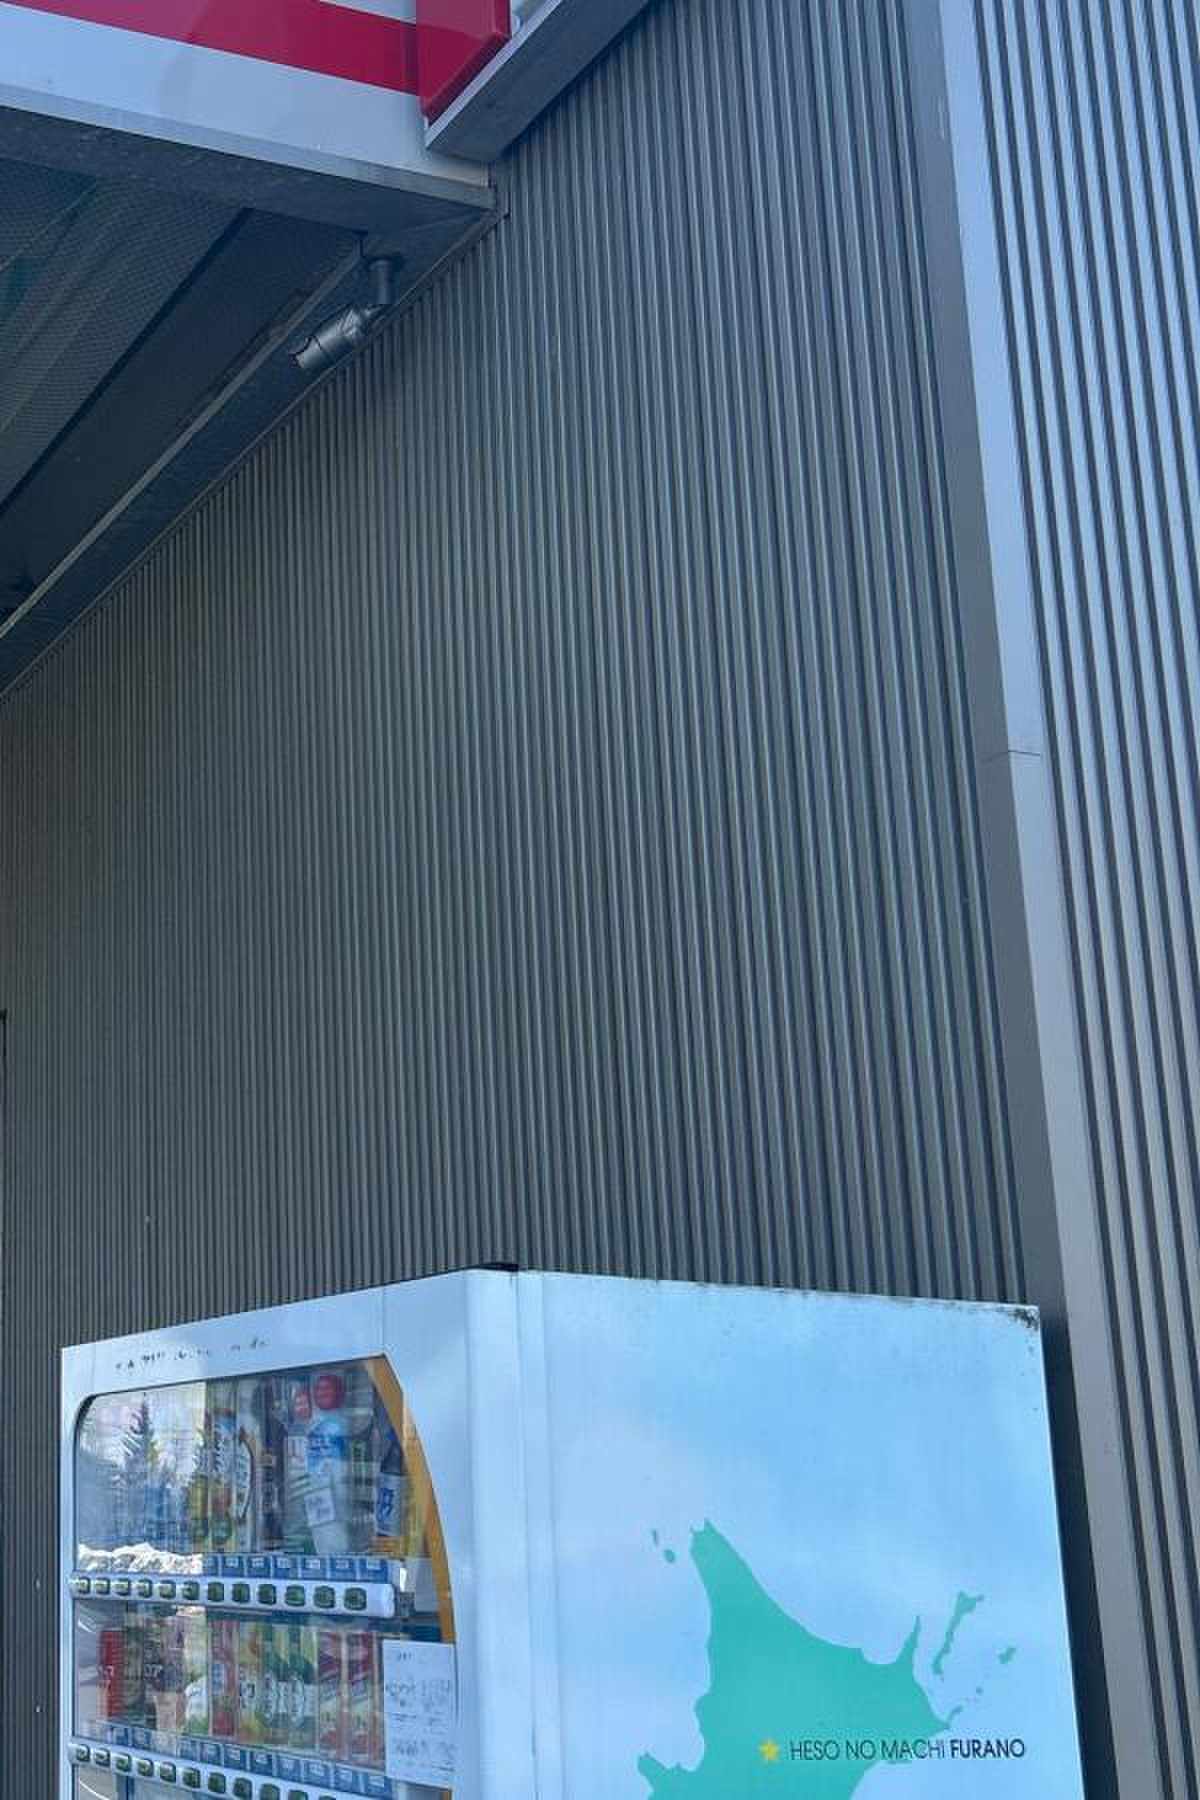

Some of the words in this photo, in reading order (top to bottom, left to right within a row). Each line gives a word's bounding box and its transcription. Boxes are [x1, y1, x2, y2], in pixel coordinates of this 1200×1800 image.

[790, 1740, 840, 1760] HESO
[846, 1740, 876, 1760] NO
[881, 1739, 946, 1760] MACHI
[951, 1738, 1026, 1759] FURANO
